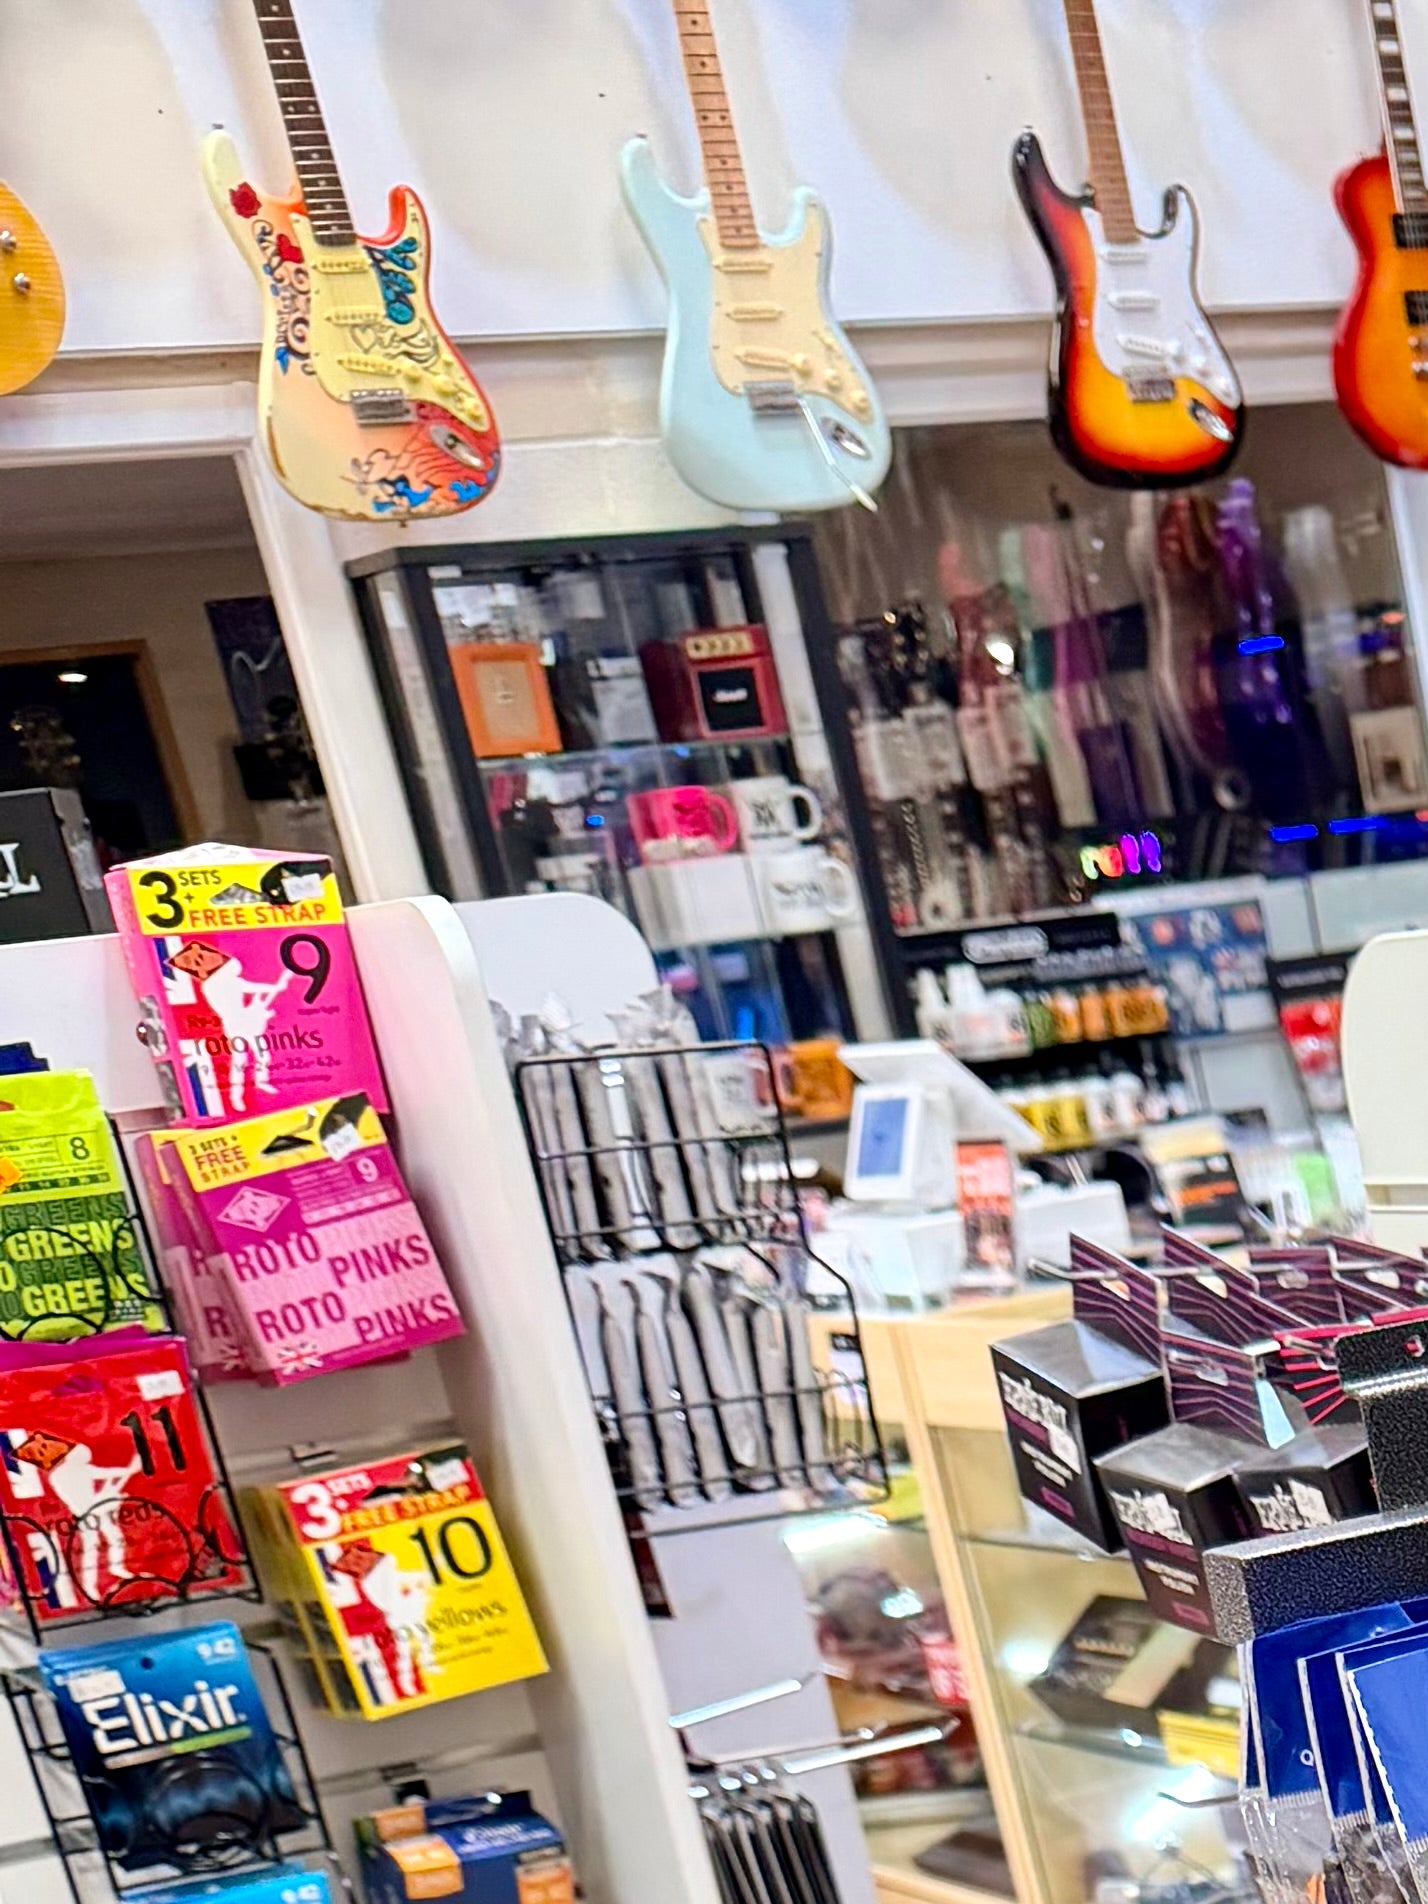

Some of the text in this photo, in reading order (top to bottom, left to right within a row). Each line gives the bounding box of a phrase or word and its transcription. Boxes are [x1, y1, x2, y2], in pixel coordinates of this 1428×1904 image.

[139, 869, 221, 929] 3 SETS
[189, 906, 248, 928] FREE
[255, 903, 326, 924] STRAP
[280, 933, 331, 1004] 9
[255, 1024, 323, 1057] pinks
[69, 1136, 90, 1161] 8
[194, 1147, 247, 1171] FREE
[200, 1162, 251, 1183] STRAP
[356, 1157, 378, 1182] 9
[5, 1217, 134, 1262] GREENS
[231, 1229, 431, 1289] ROTO PINKS
[256, 1291, 452, 1345] ROTO PINKS
[120, 1405, 187, 1477] 11
[291, 1483, 341, 1540] 3
[410, 1516, 493, 1586] 10
[82, 1681, 239, 1754] Elixir
